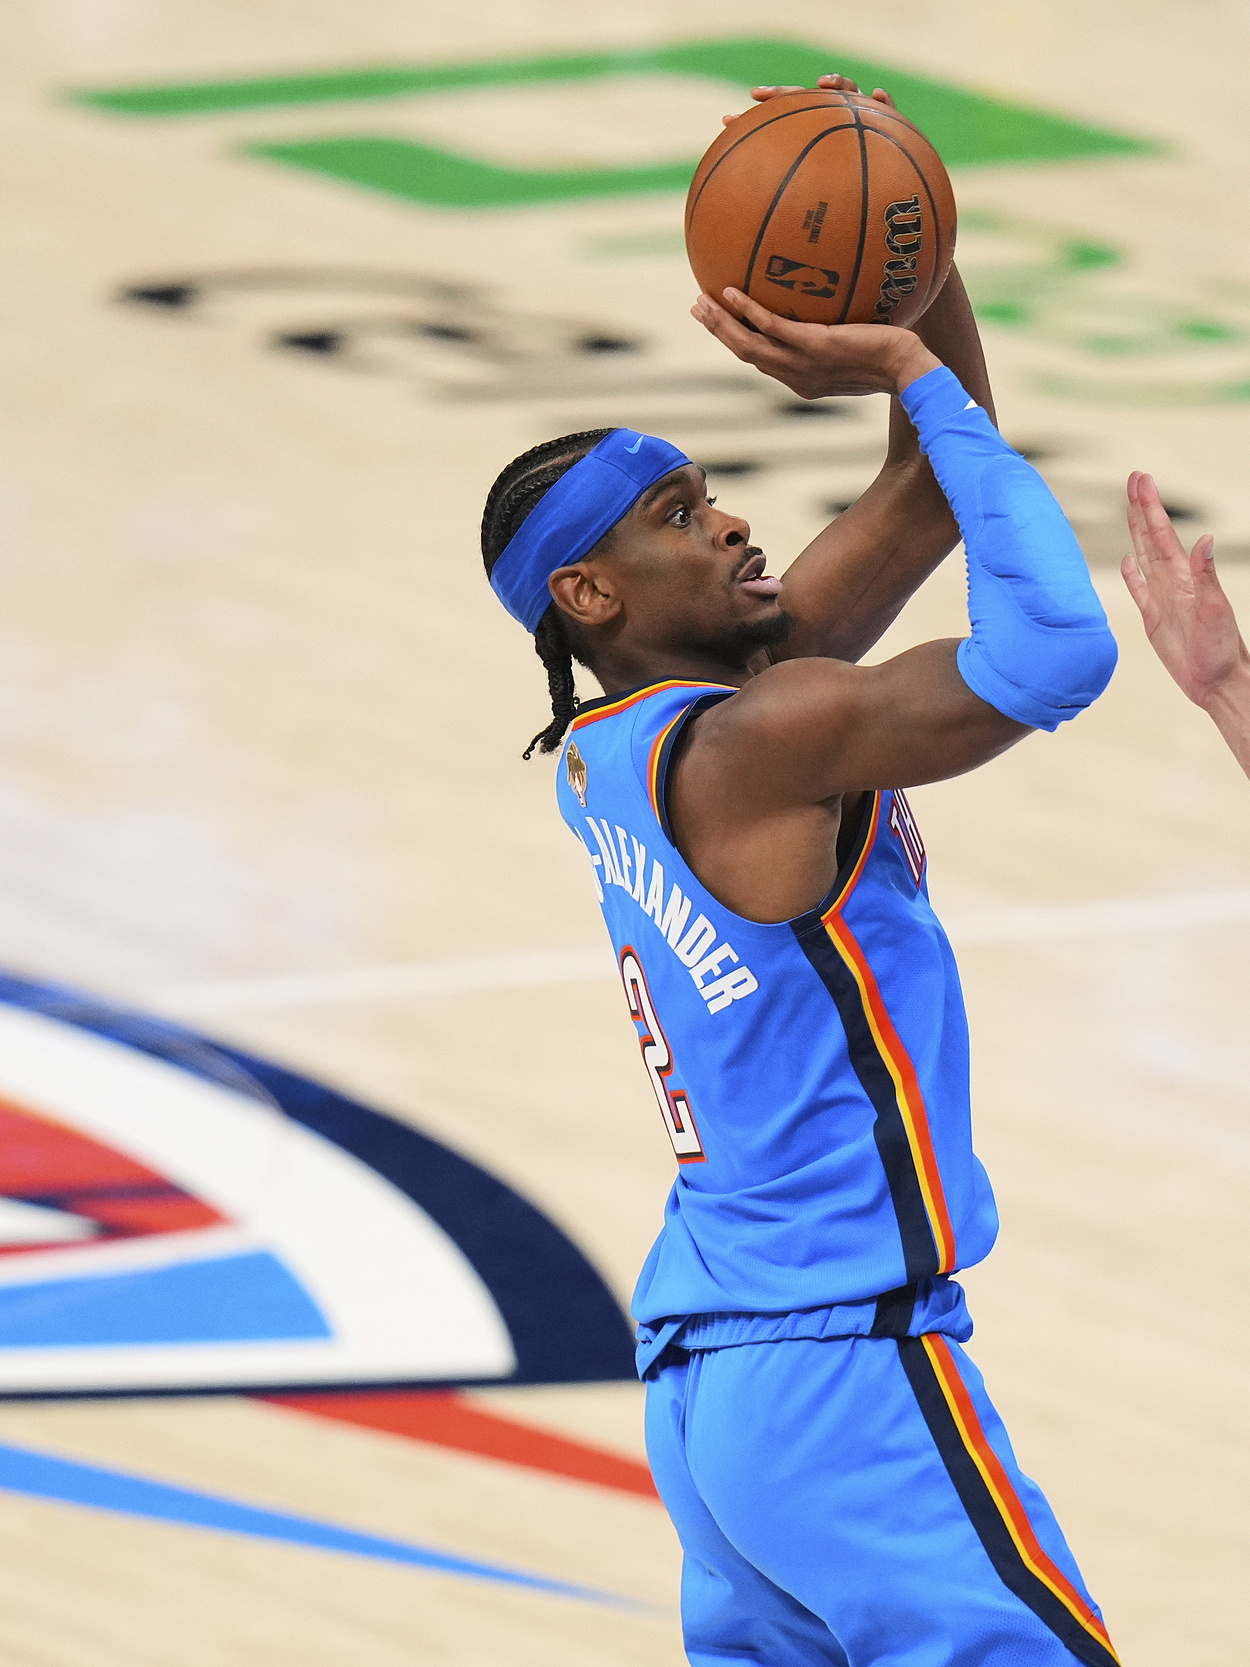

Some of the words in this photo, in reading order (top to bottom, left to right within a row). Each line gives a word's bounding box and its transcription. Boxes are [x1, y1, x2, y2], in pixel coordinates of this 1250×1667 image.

[868, 194, 923, 324] Wils
[576, 816, 758, 1015] -ALEXANDER
[619, 944, 707, 1164] 2
